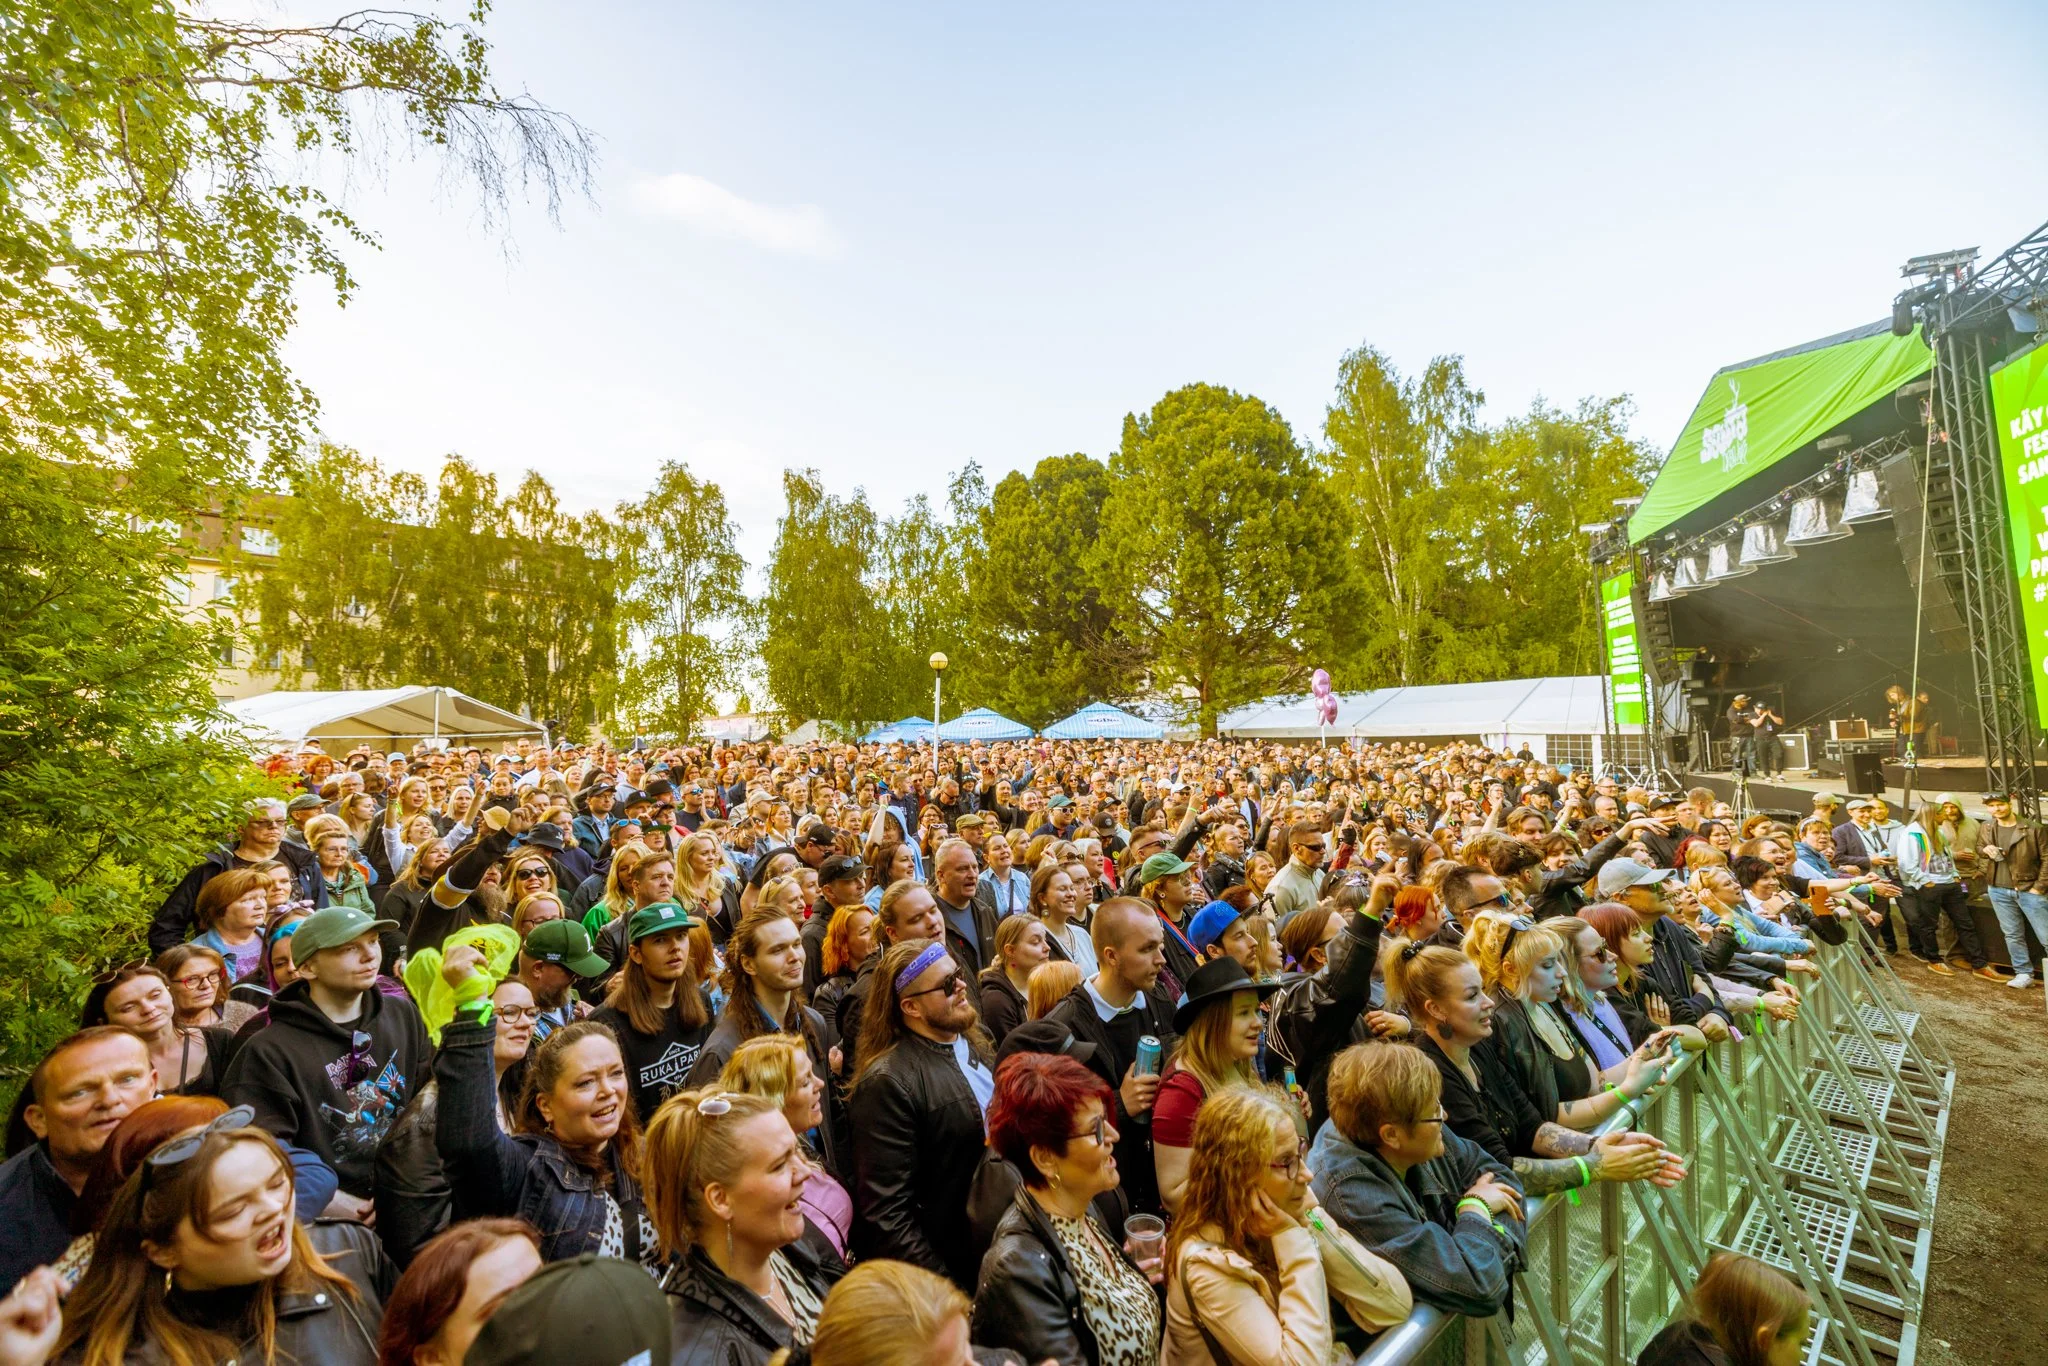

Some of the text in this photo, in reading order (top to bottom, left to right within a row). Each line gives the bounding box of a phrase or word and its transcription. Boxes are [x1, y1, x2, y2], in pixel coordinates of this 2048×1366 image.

[2009, 407, 2043, 440] KÄY
[640, 1049, 701, 1083] RUKA PAR
